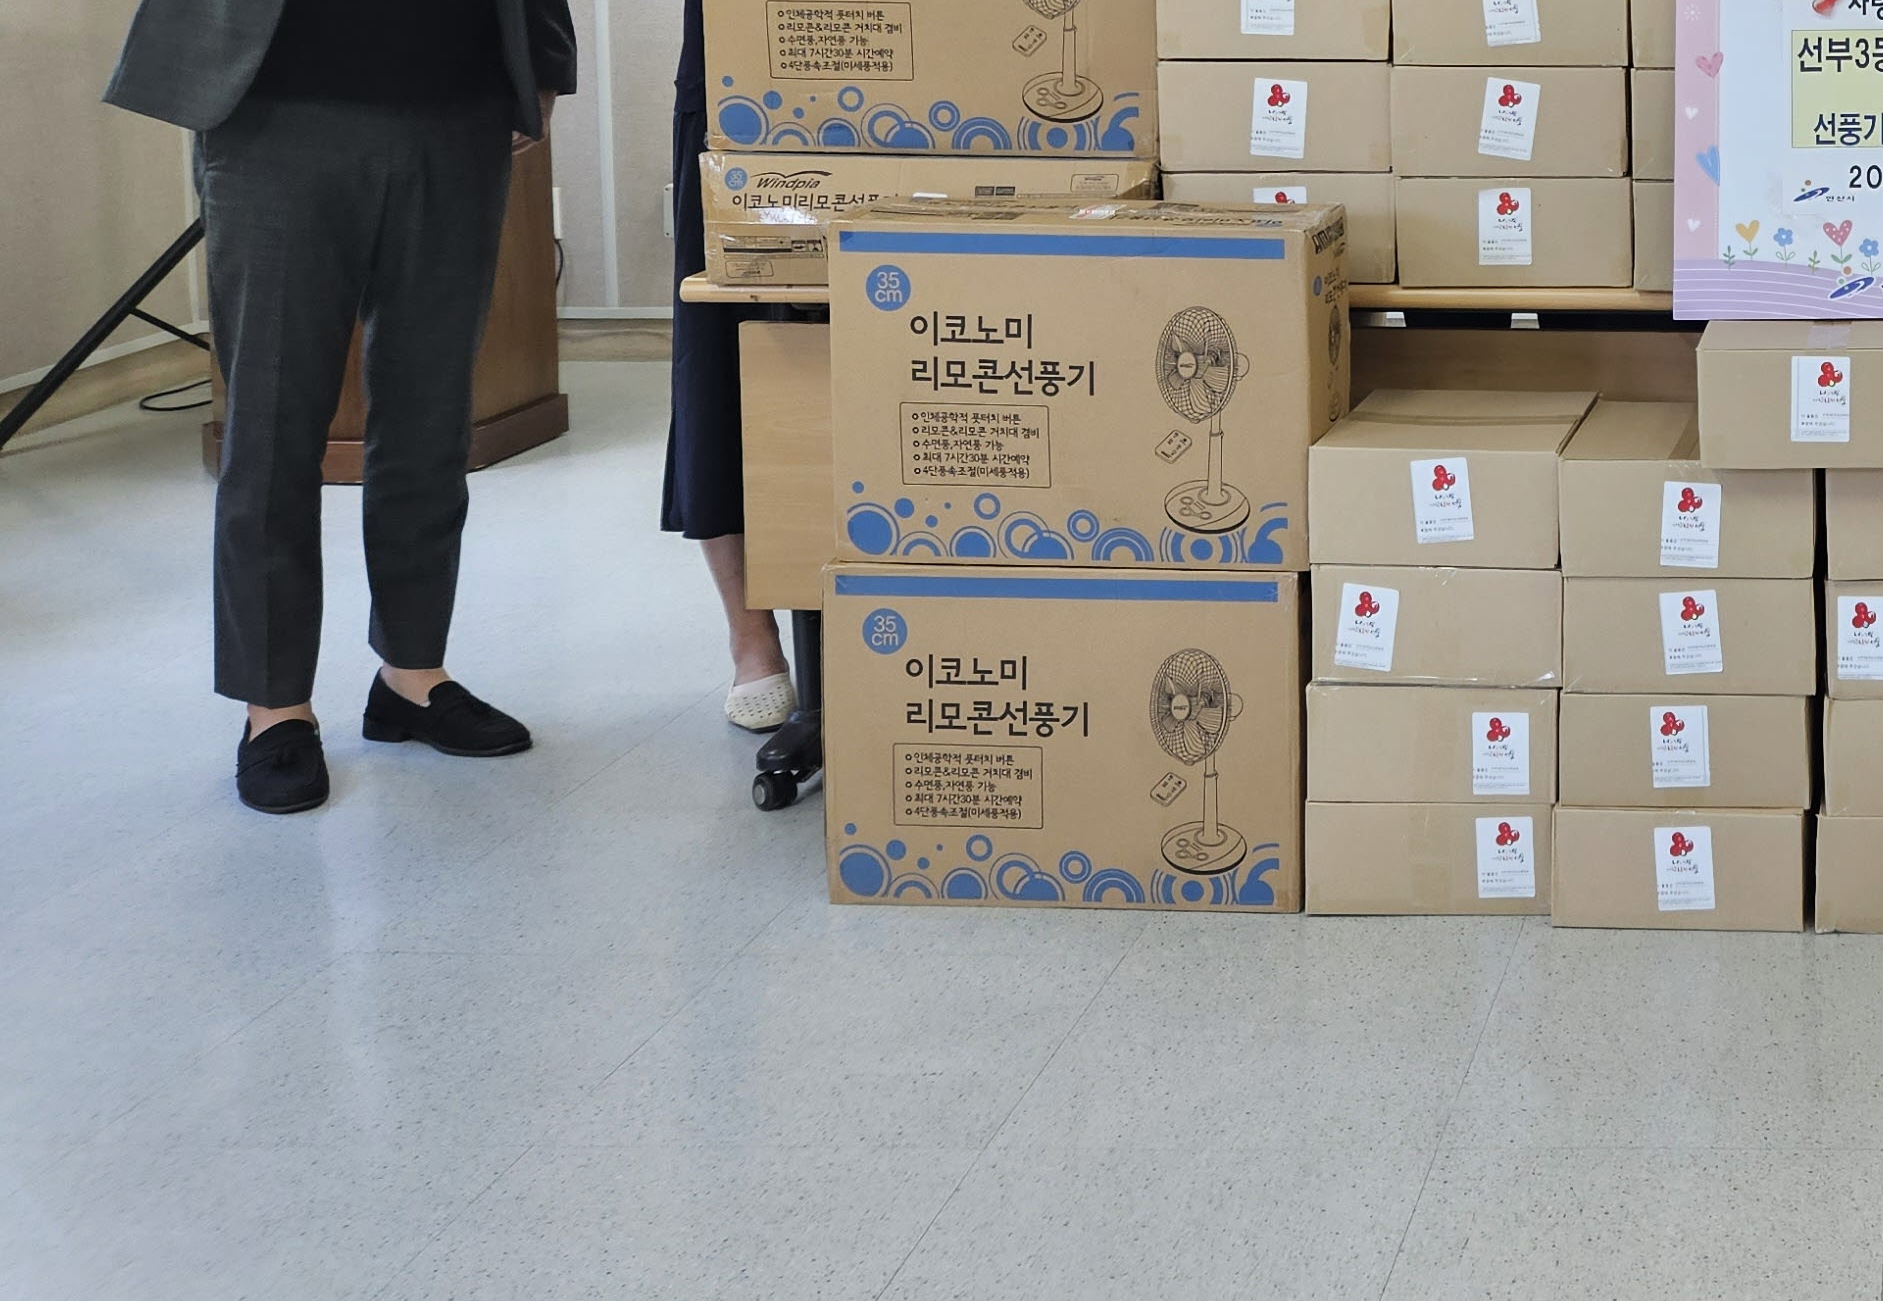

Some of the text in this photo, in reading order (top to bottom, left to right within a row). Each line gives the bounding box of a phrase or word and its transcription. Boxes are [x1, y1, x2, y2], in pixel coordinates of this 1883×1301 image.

[786, 22, 851, 33] 리모콘&리모콘
[854, 23, 881, 34] 거치대
[849, 36, 868, 46] 기능
[810, 48, 852, 59] 7시간30분
[756, 177, 821, 189] Windpia
[876, 273, 899, 289] 35
[874, 289, 902, 303] cm
[909, 312, 1032, 348] 이코노미
[911, 357, 1095, 396] 리모콘선풍기
[921, 425, 987, 438] 리모콘&리모콘
[990, 426, 1018, 438] 거치대
[985, 440, 1004, 451] 기능
[945, 453, 988, 464] 7시간30분
[873, 616, 896, 632] 35
[870, 631, 898, 646] cm
[905, 654, 1026, 690] 이코노미
[906, 699, 1089, 737] 리모콘선풍기
[914, 766, 980, 779] 리모콘&리모콘
[983, 767, 1011, 779] 거치대
[978, 781, 997, 792] 기능
[937, 794, 981, 805] 7시간30분
